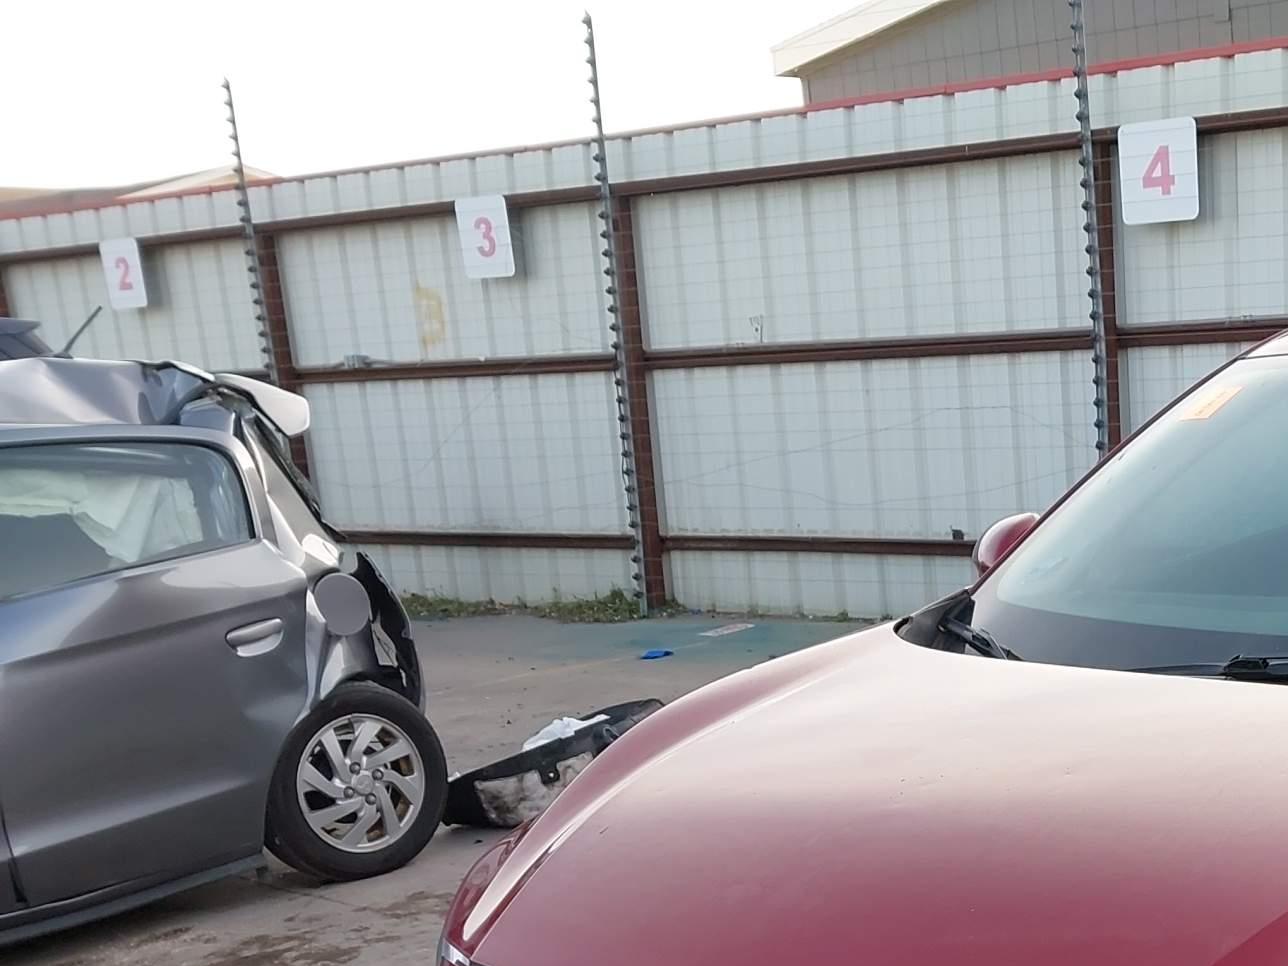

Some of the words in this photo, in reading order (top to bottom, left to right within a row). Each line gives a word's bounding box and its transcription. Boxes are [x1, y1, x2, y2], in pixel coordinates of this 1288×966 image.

[1142, 144, 1175, 196] 4
[473, 216, 497, 257] 3
[114, 256, 133, 291] 2
